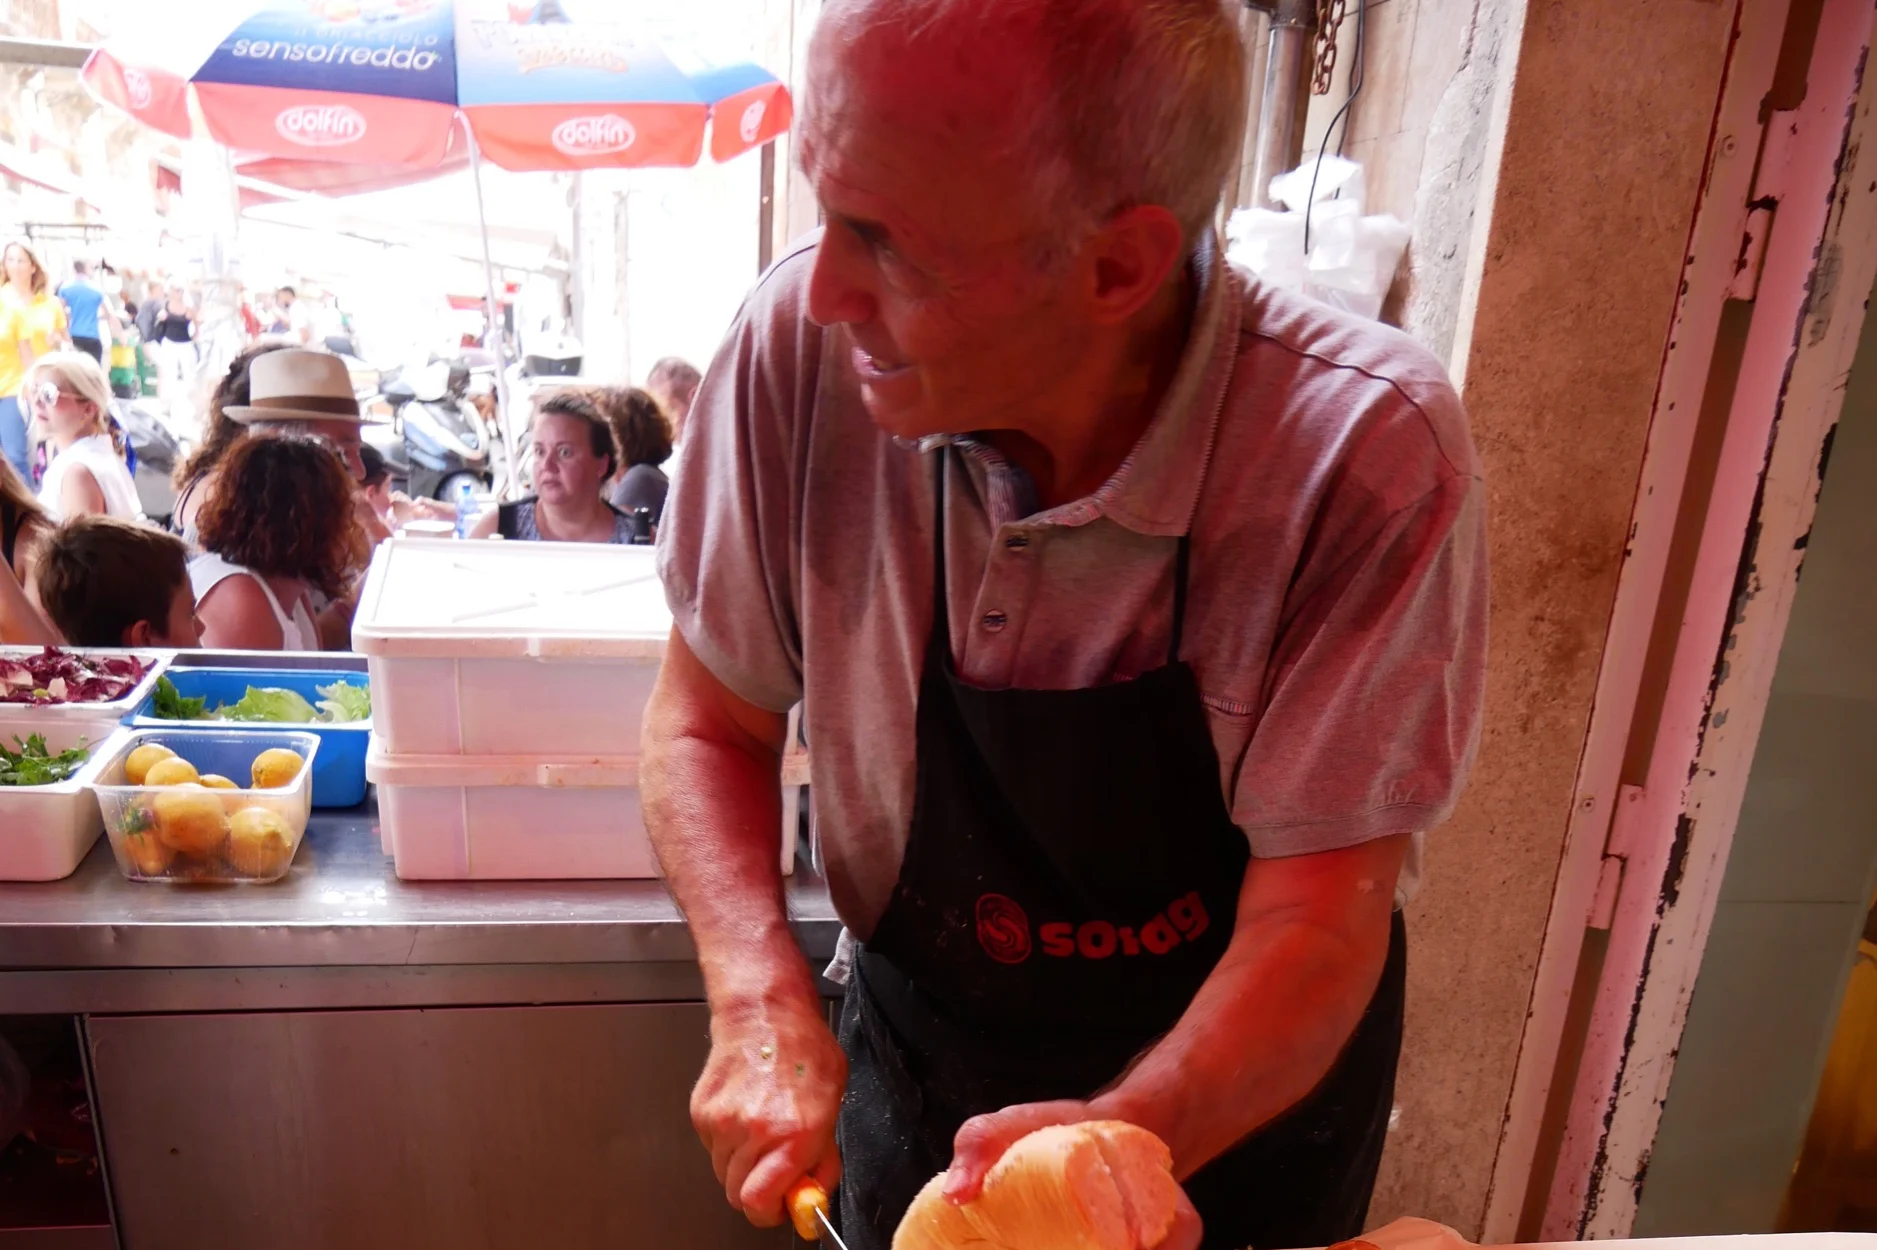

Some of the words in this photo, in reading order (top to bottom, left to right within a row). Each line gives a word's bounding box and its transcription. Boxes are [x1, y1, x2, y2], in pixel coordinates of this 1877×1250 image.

[232, 38, 436, 70] sensofreddo
[286, 105, 355, 135] dolfin
[562, 118, 625, 145] dolfin
